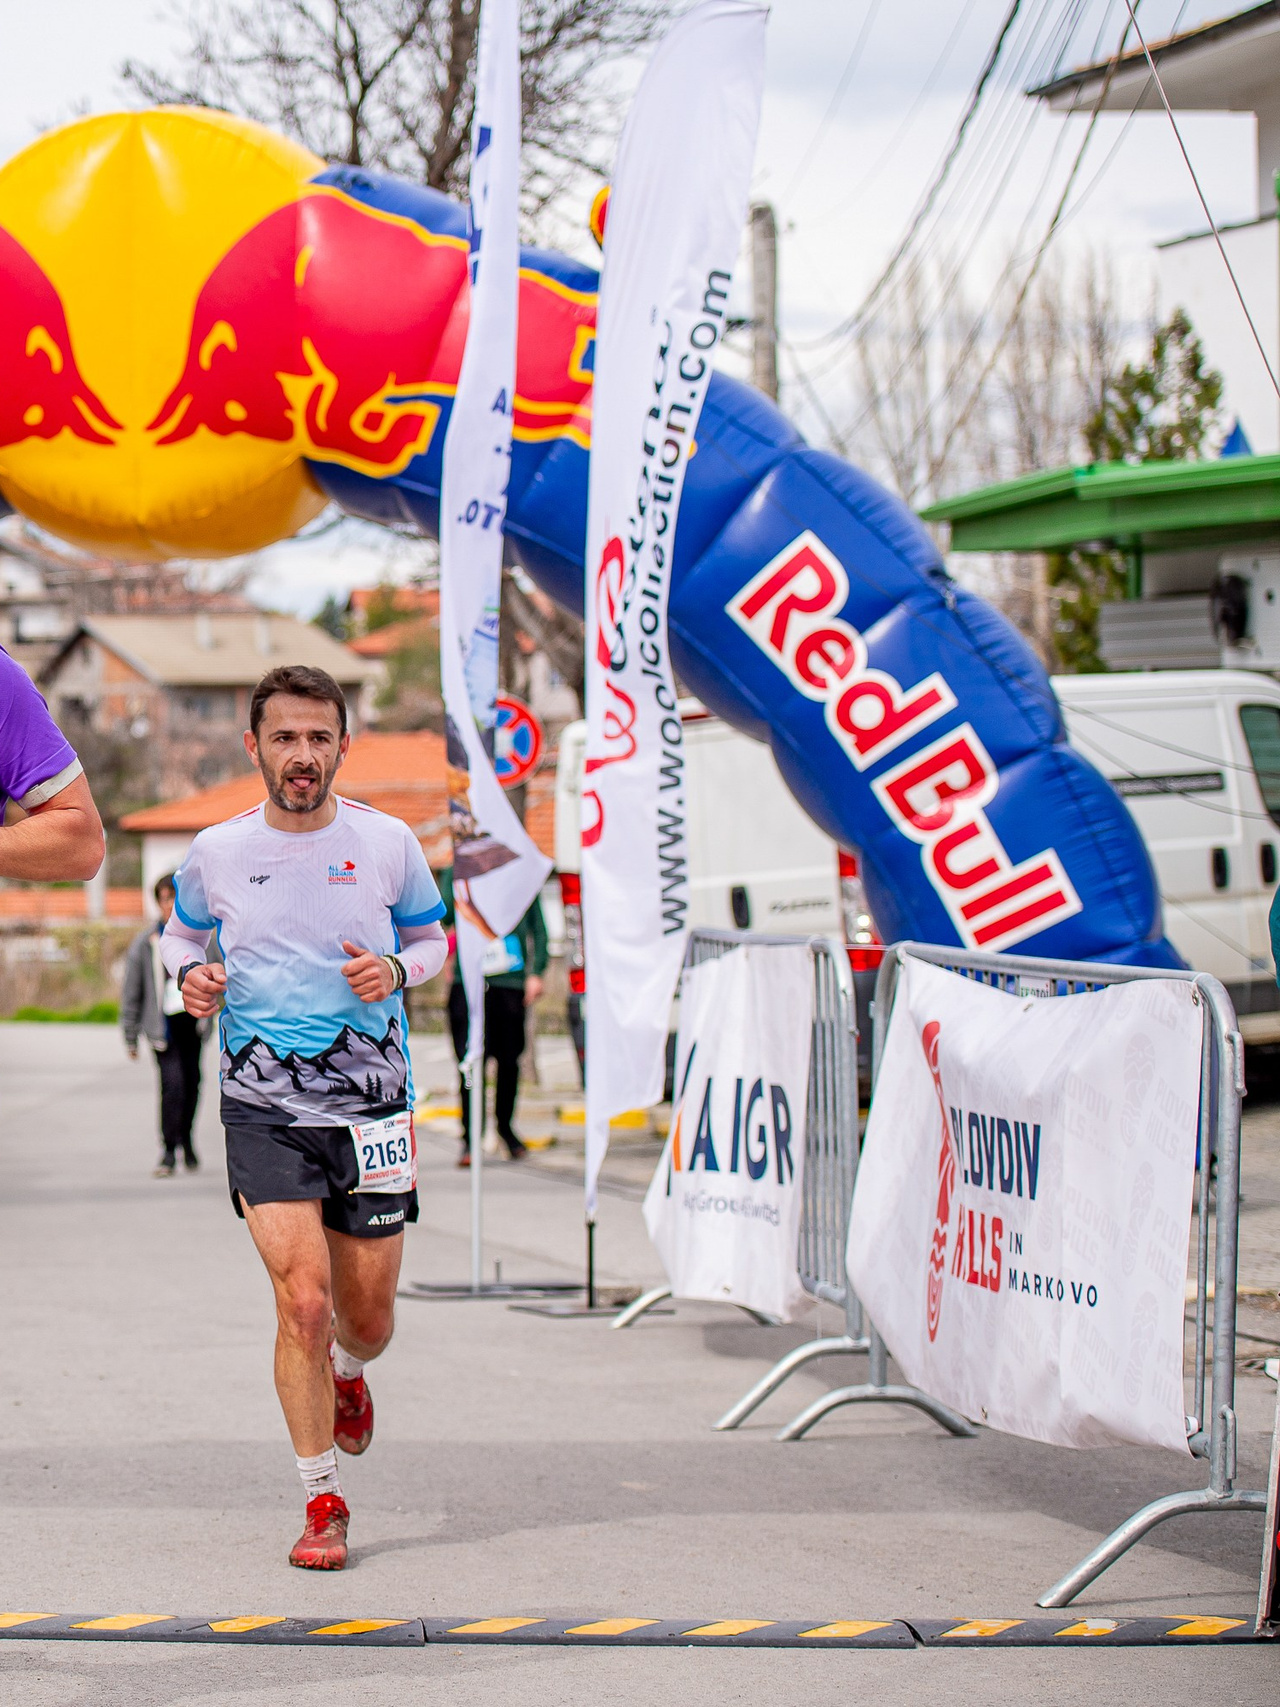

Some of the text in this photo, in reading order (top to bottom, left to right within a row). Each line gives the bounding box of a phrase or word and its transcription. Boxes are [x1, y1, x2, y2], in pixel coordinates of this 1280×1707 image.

[732, 537, 1075, 952] Red Bull
[362, 1137, 408, 1171] 2163
[364, 1171, 390, 1181] MARKOVO
[1009, 1231, 1023, 1256] IN
[1008, 1267, 1098, 1307] MARKOVO
